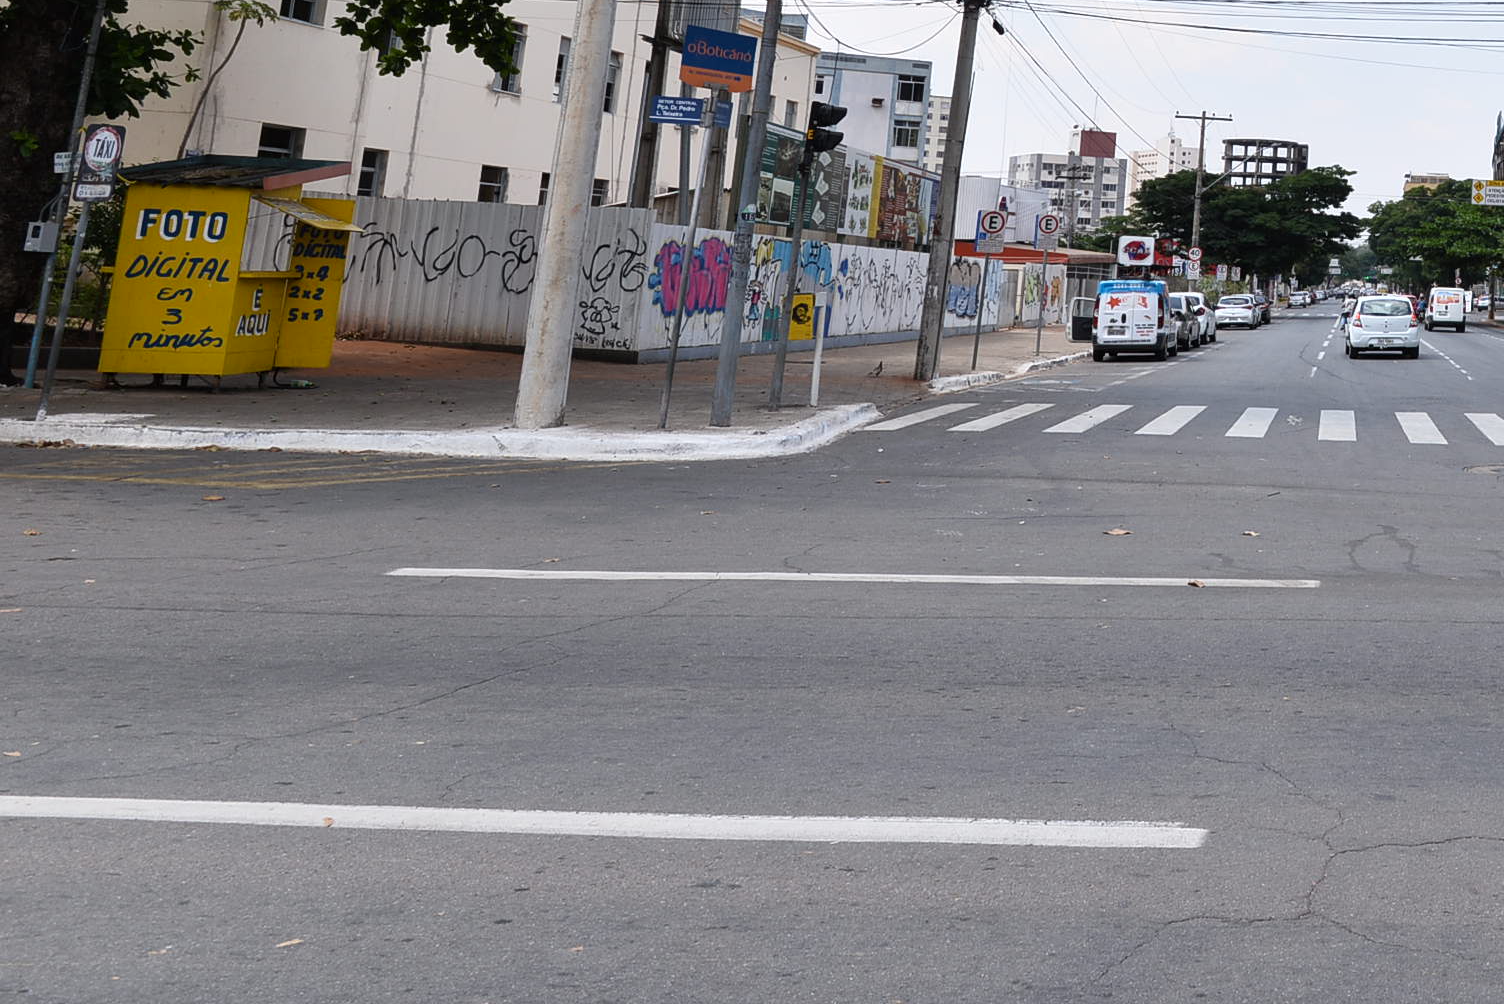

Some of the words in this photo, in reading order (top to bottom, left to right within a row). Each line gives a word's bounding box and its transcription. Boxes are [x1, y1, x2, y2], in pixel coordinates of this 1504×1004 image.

[807, 129, 815, 140] E
[93, 136, 116, 159] TÁXI
[135, 208, 229, 243] FOTO
[988, 215, 999, 230] E
[1044, 218, 1053, 230] E
[125, 251, 230, 283] DIGITAL
[162, 308, 182, 325] 3
